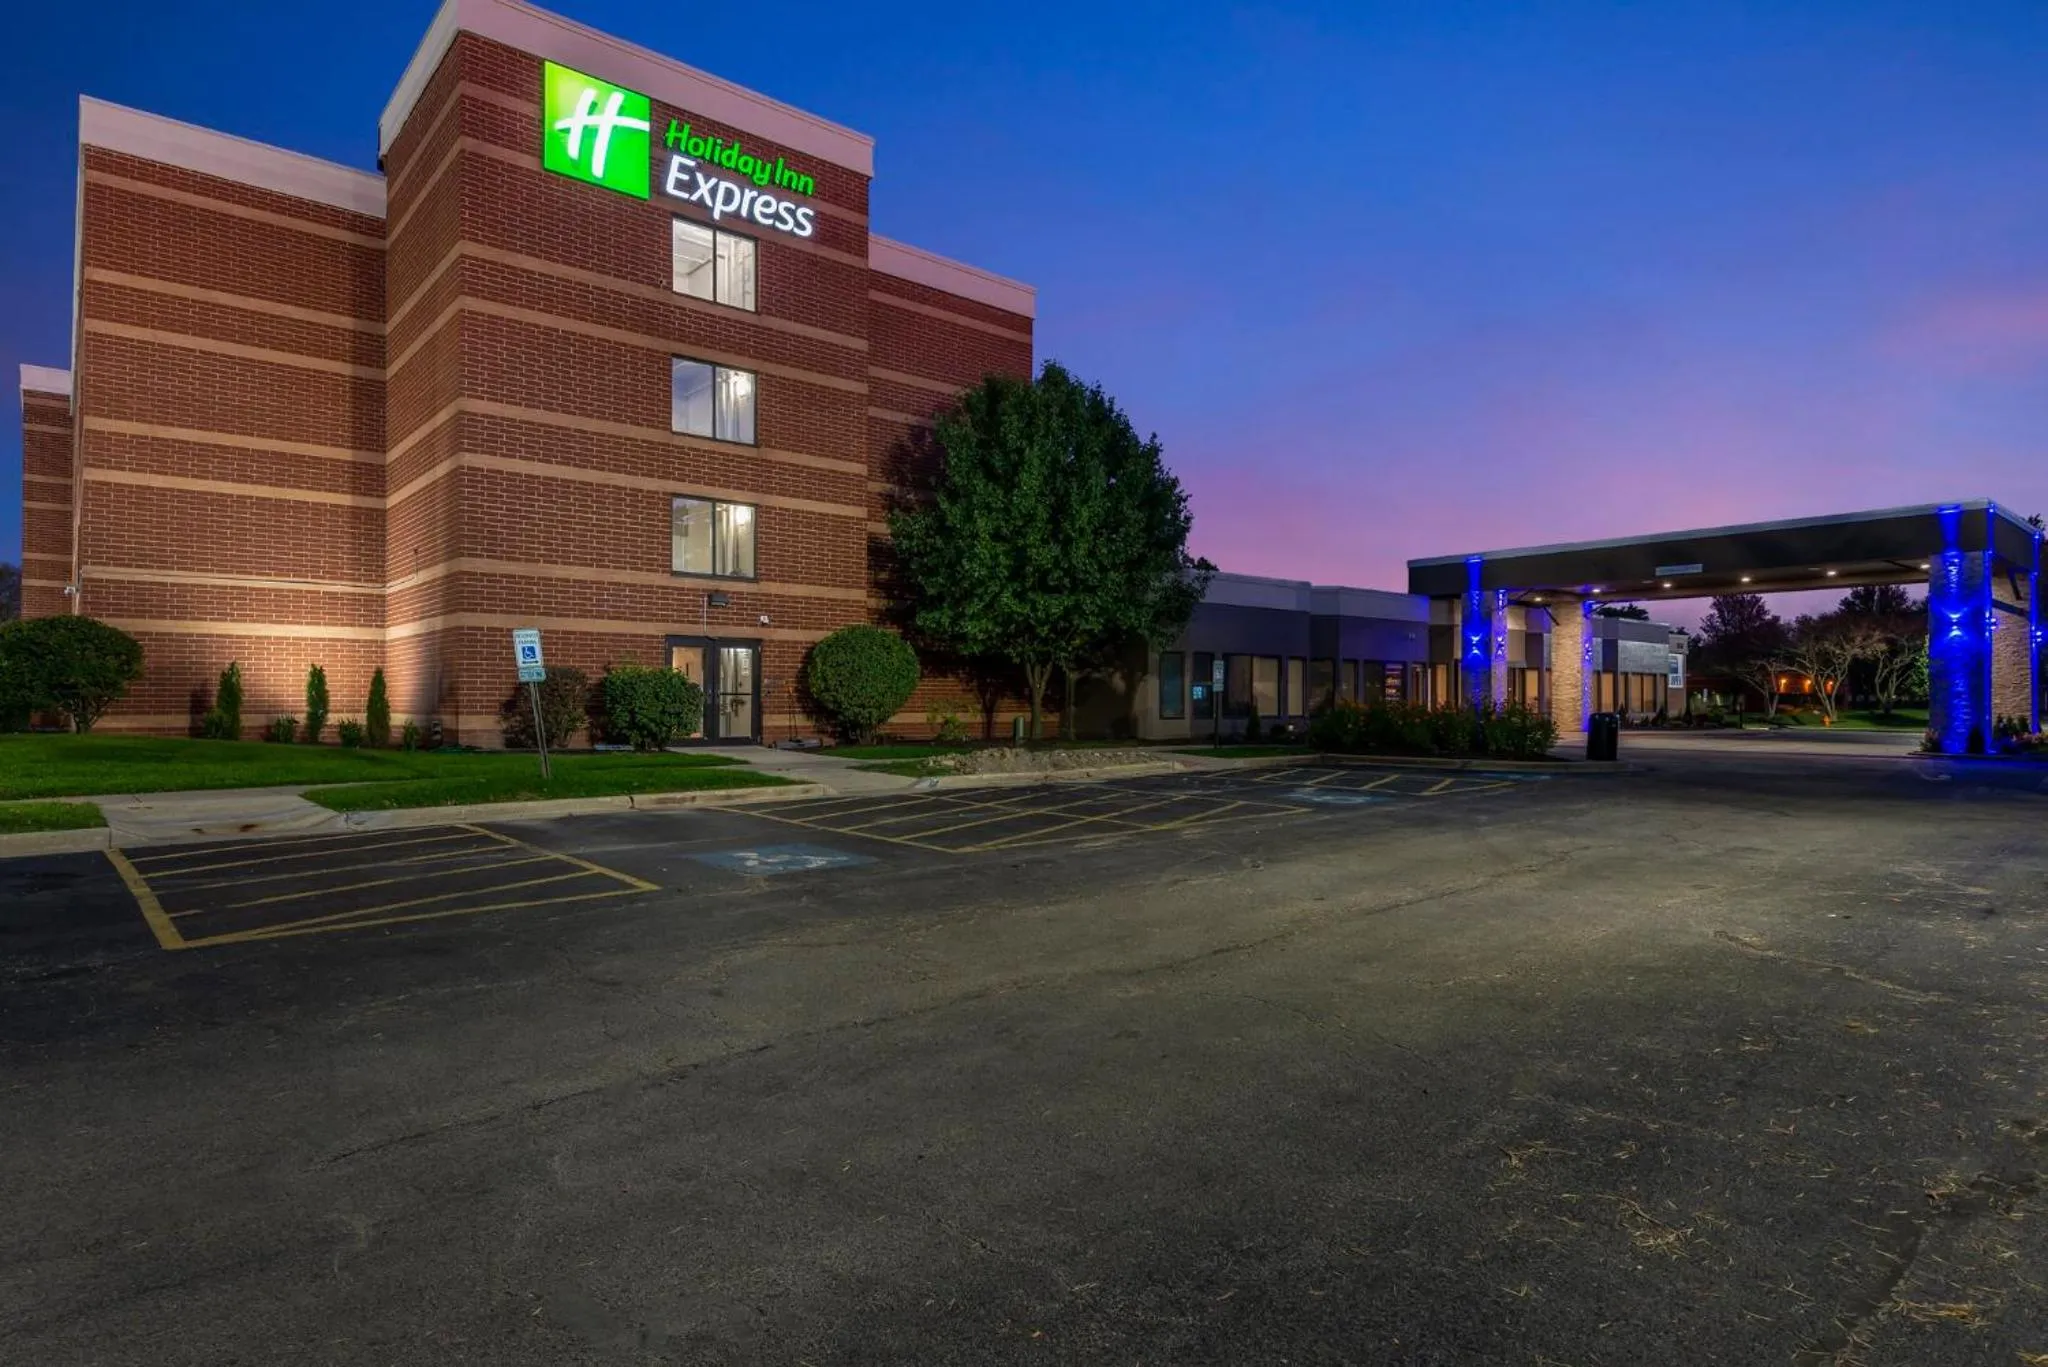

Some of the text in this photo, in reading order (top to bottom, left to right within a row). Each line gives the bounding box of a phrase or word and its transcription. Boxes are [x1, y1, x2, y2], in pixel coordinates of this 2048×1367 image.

[665, 117, 815, 196] Holiday Inn
[665, 153, 815, 238] Express
